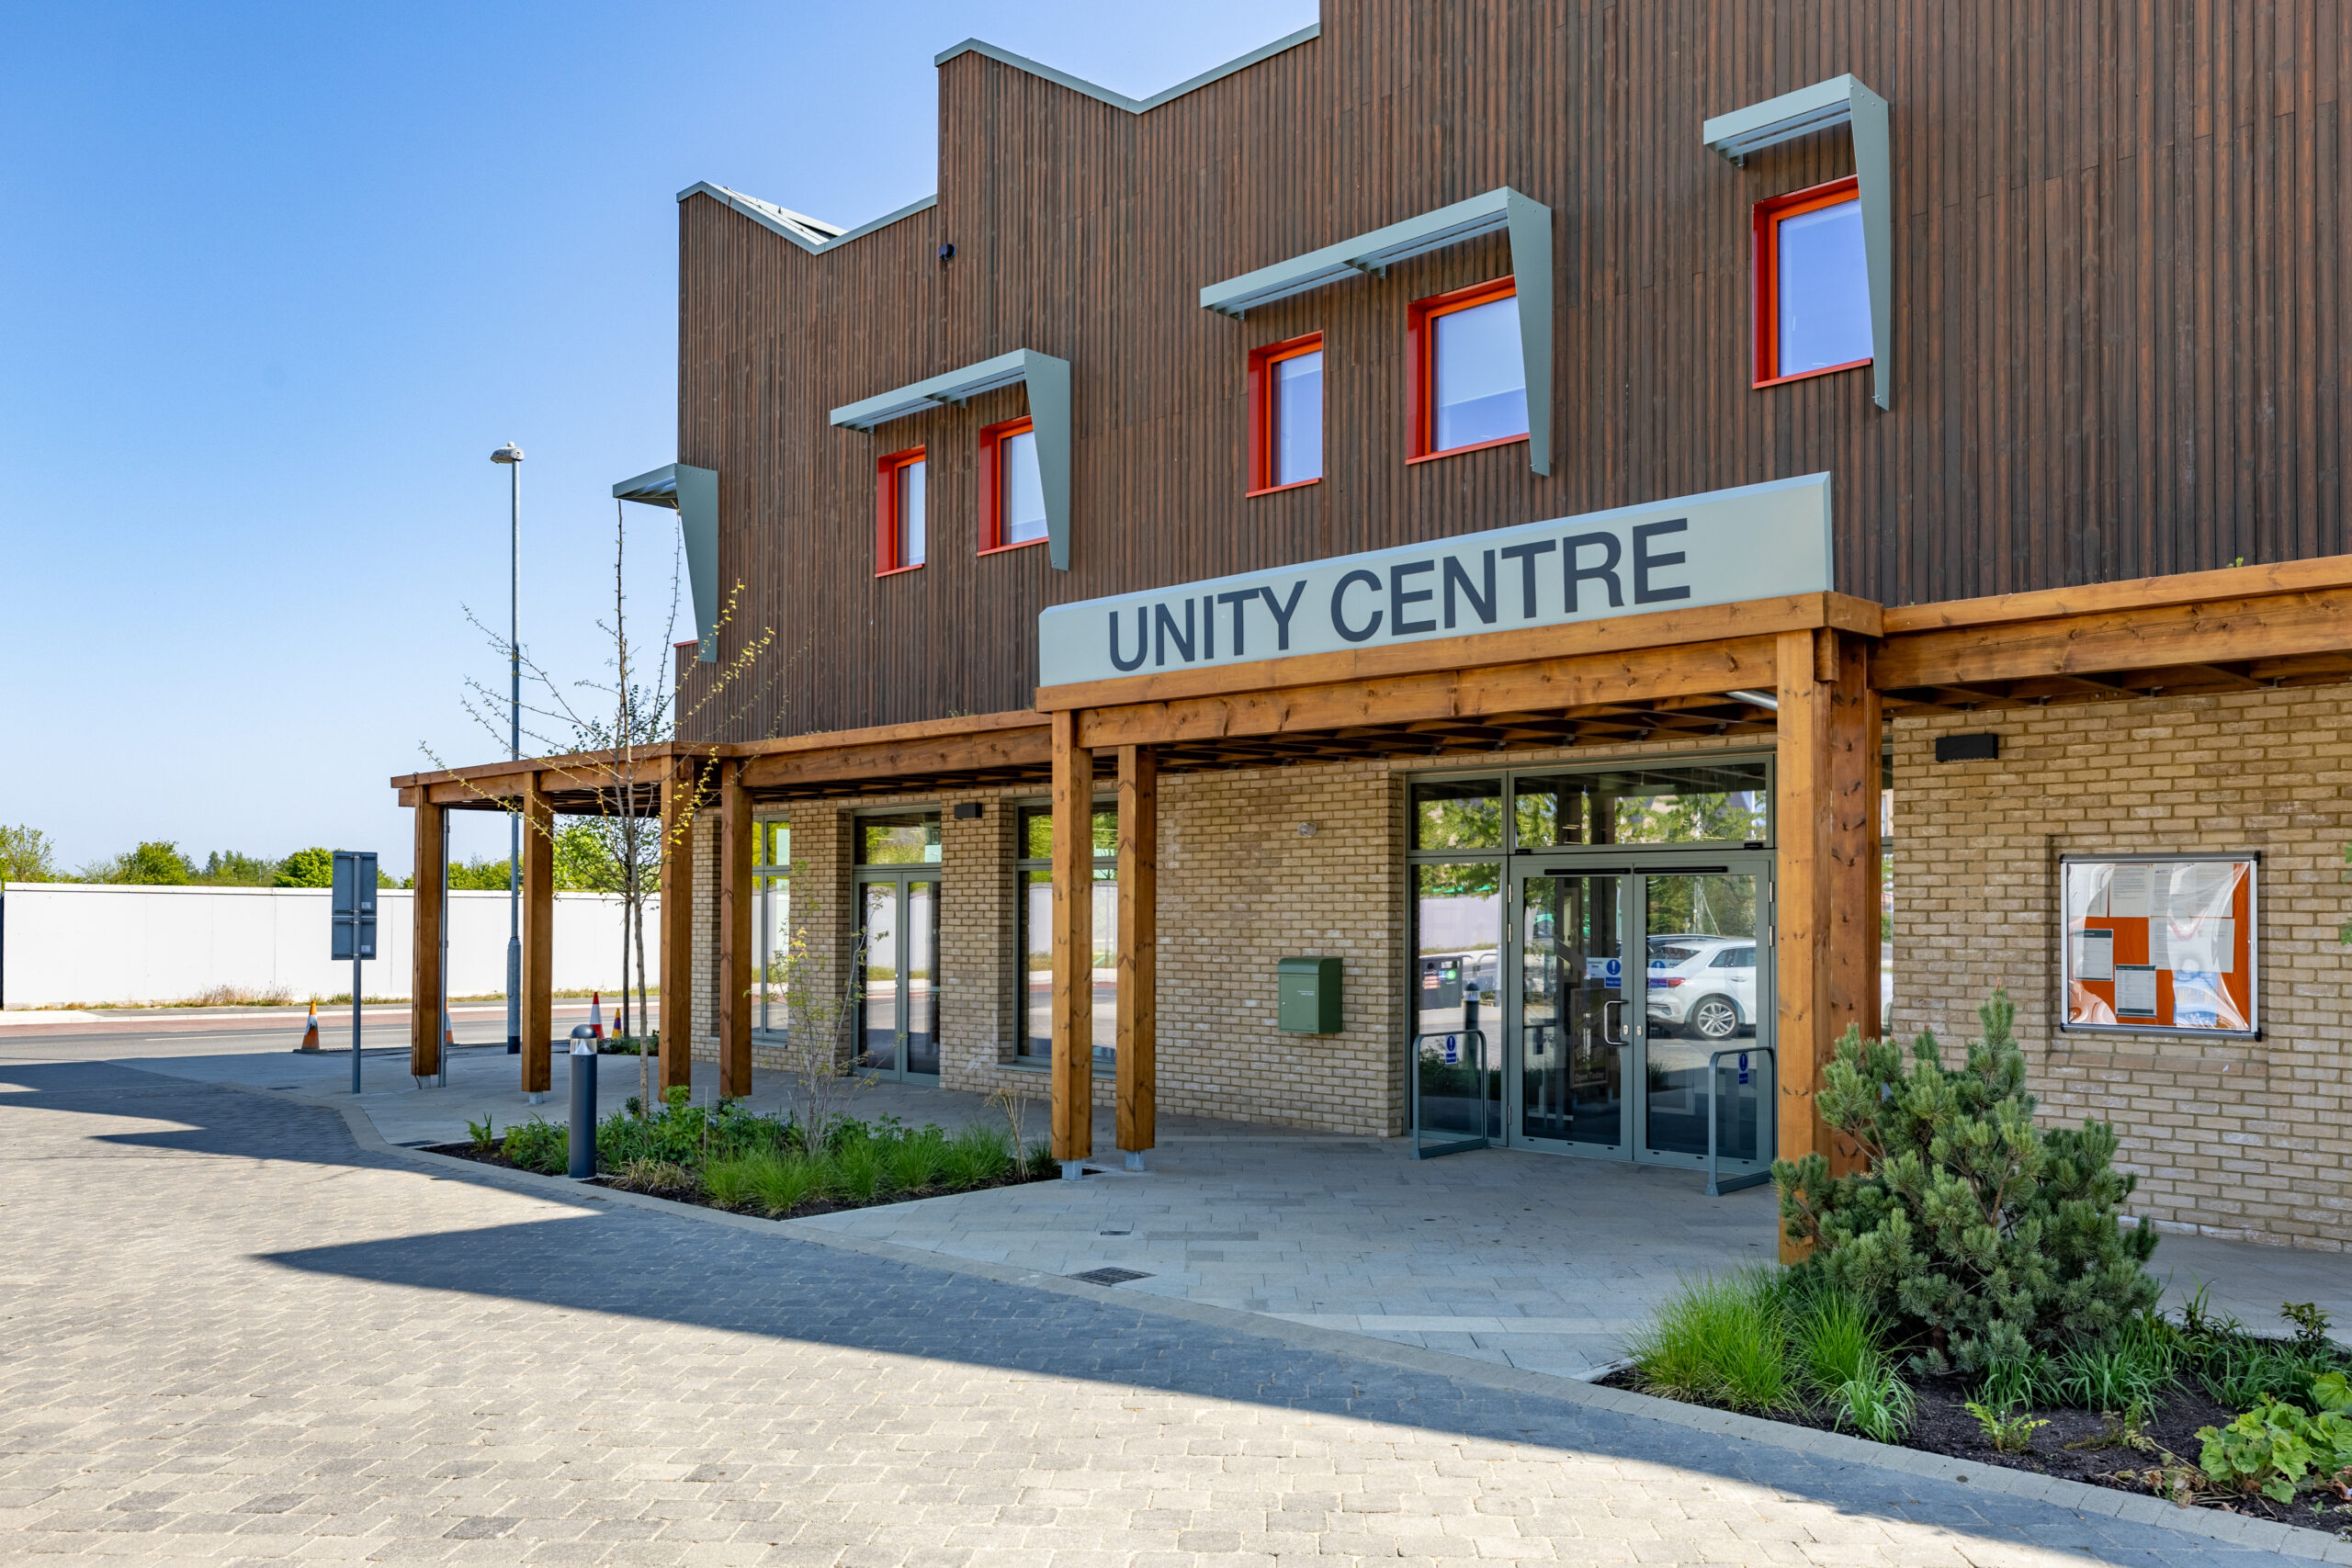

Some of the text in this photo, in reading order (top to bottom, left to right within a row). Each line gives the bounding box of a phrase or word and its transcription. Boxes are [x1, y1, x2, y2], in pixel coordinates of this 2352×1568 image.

[1109, 517, 1690, 672] UNITY CENTRE
[1575, 1072, 1604, 1083] Open Today
